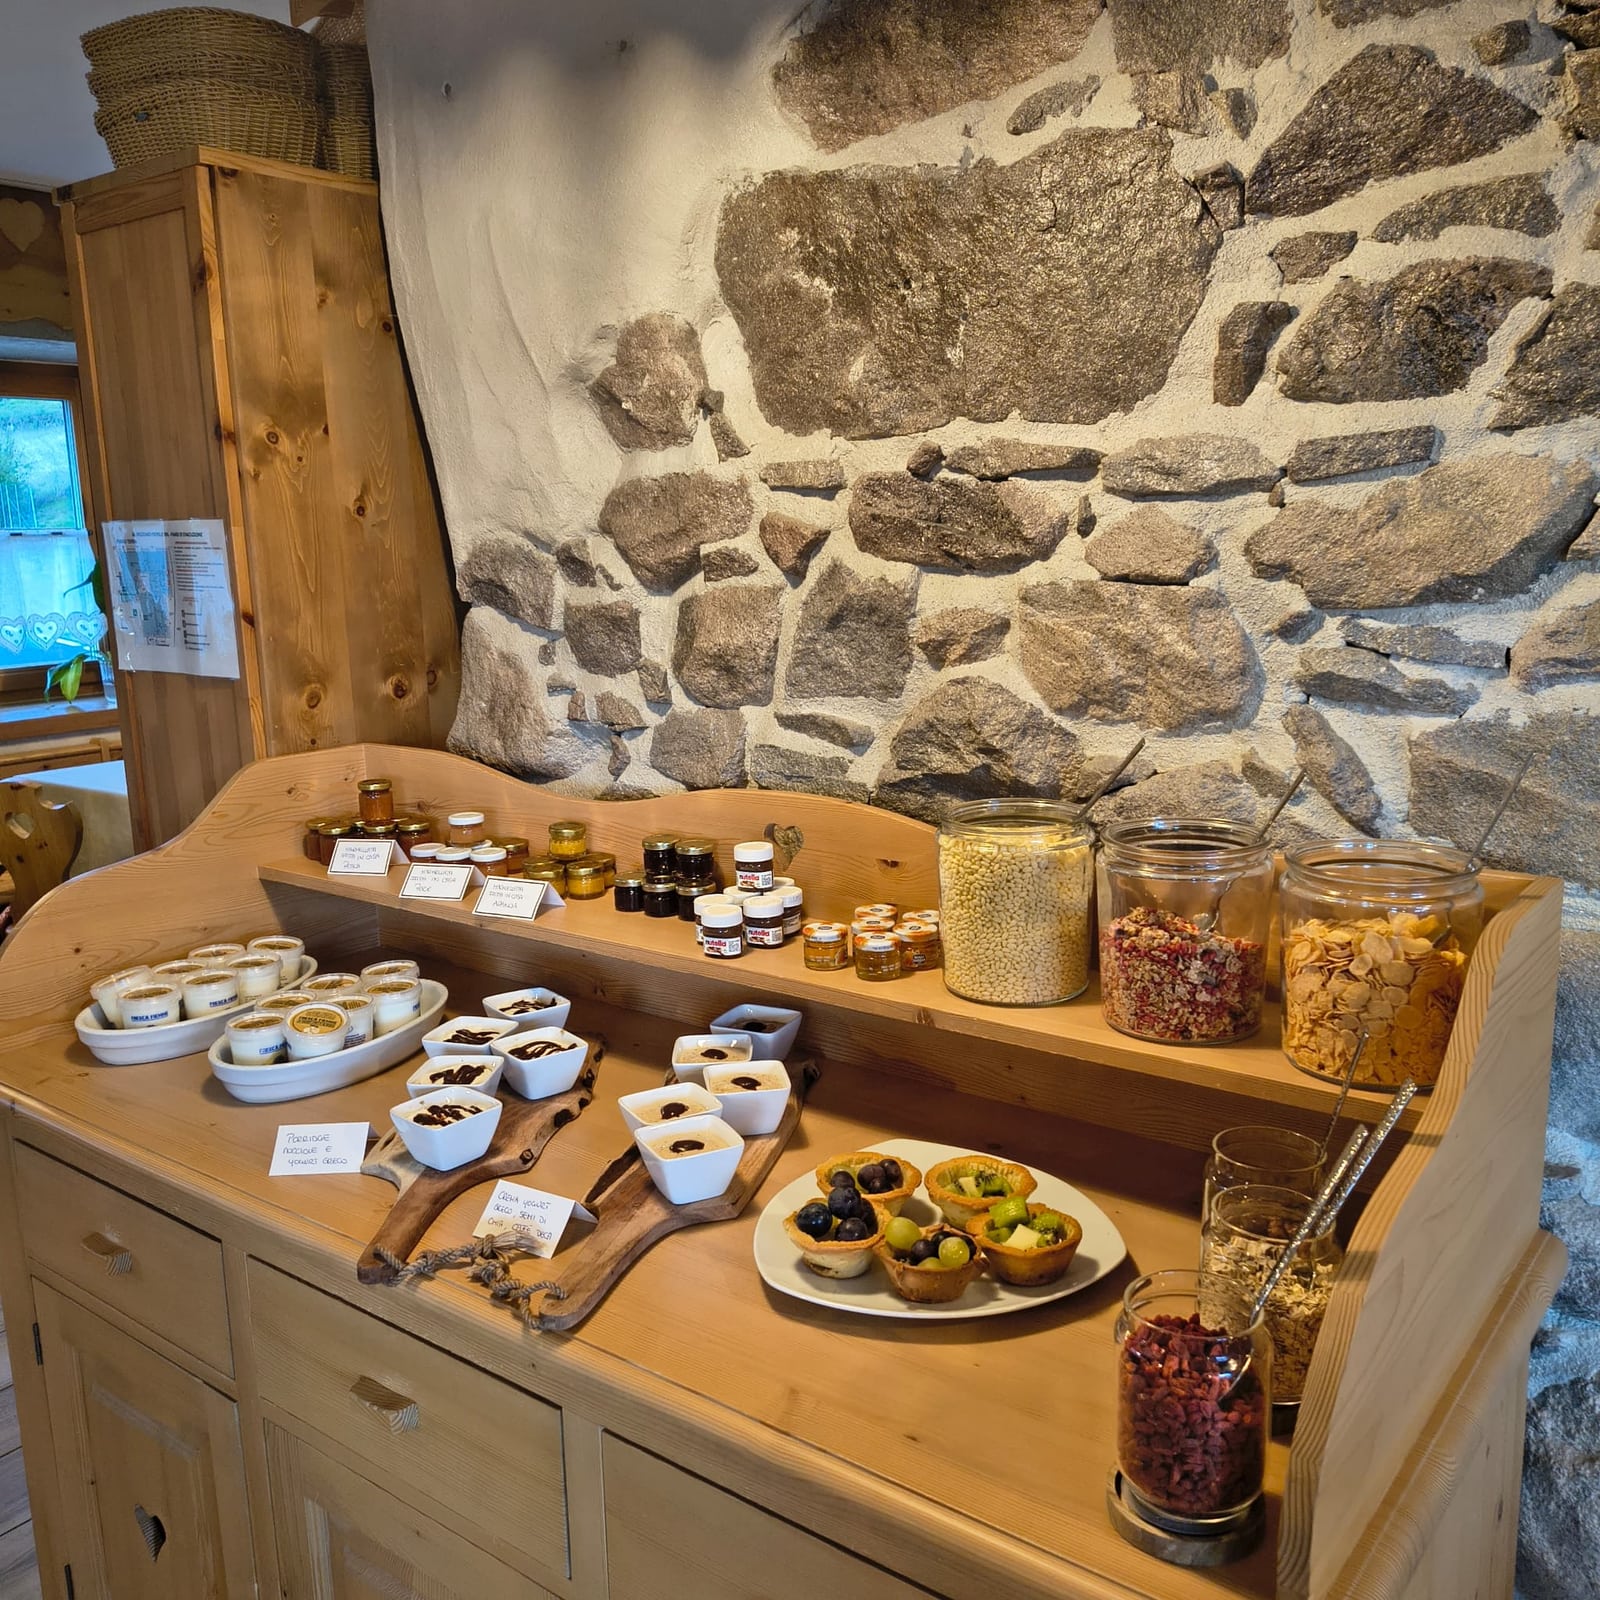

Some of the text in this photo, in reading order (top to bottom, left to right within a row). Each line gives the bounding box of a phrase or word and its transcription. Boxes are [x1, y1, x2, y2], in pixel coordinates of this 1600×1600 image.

[748, 929, 770, 937] nutella
[287, 1133, 330, 1143] PORRIDGE
[519, 1210, 536, 1220] SEMI
